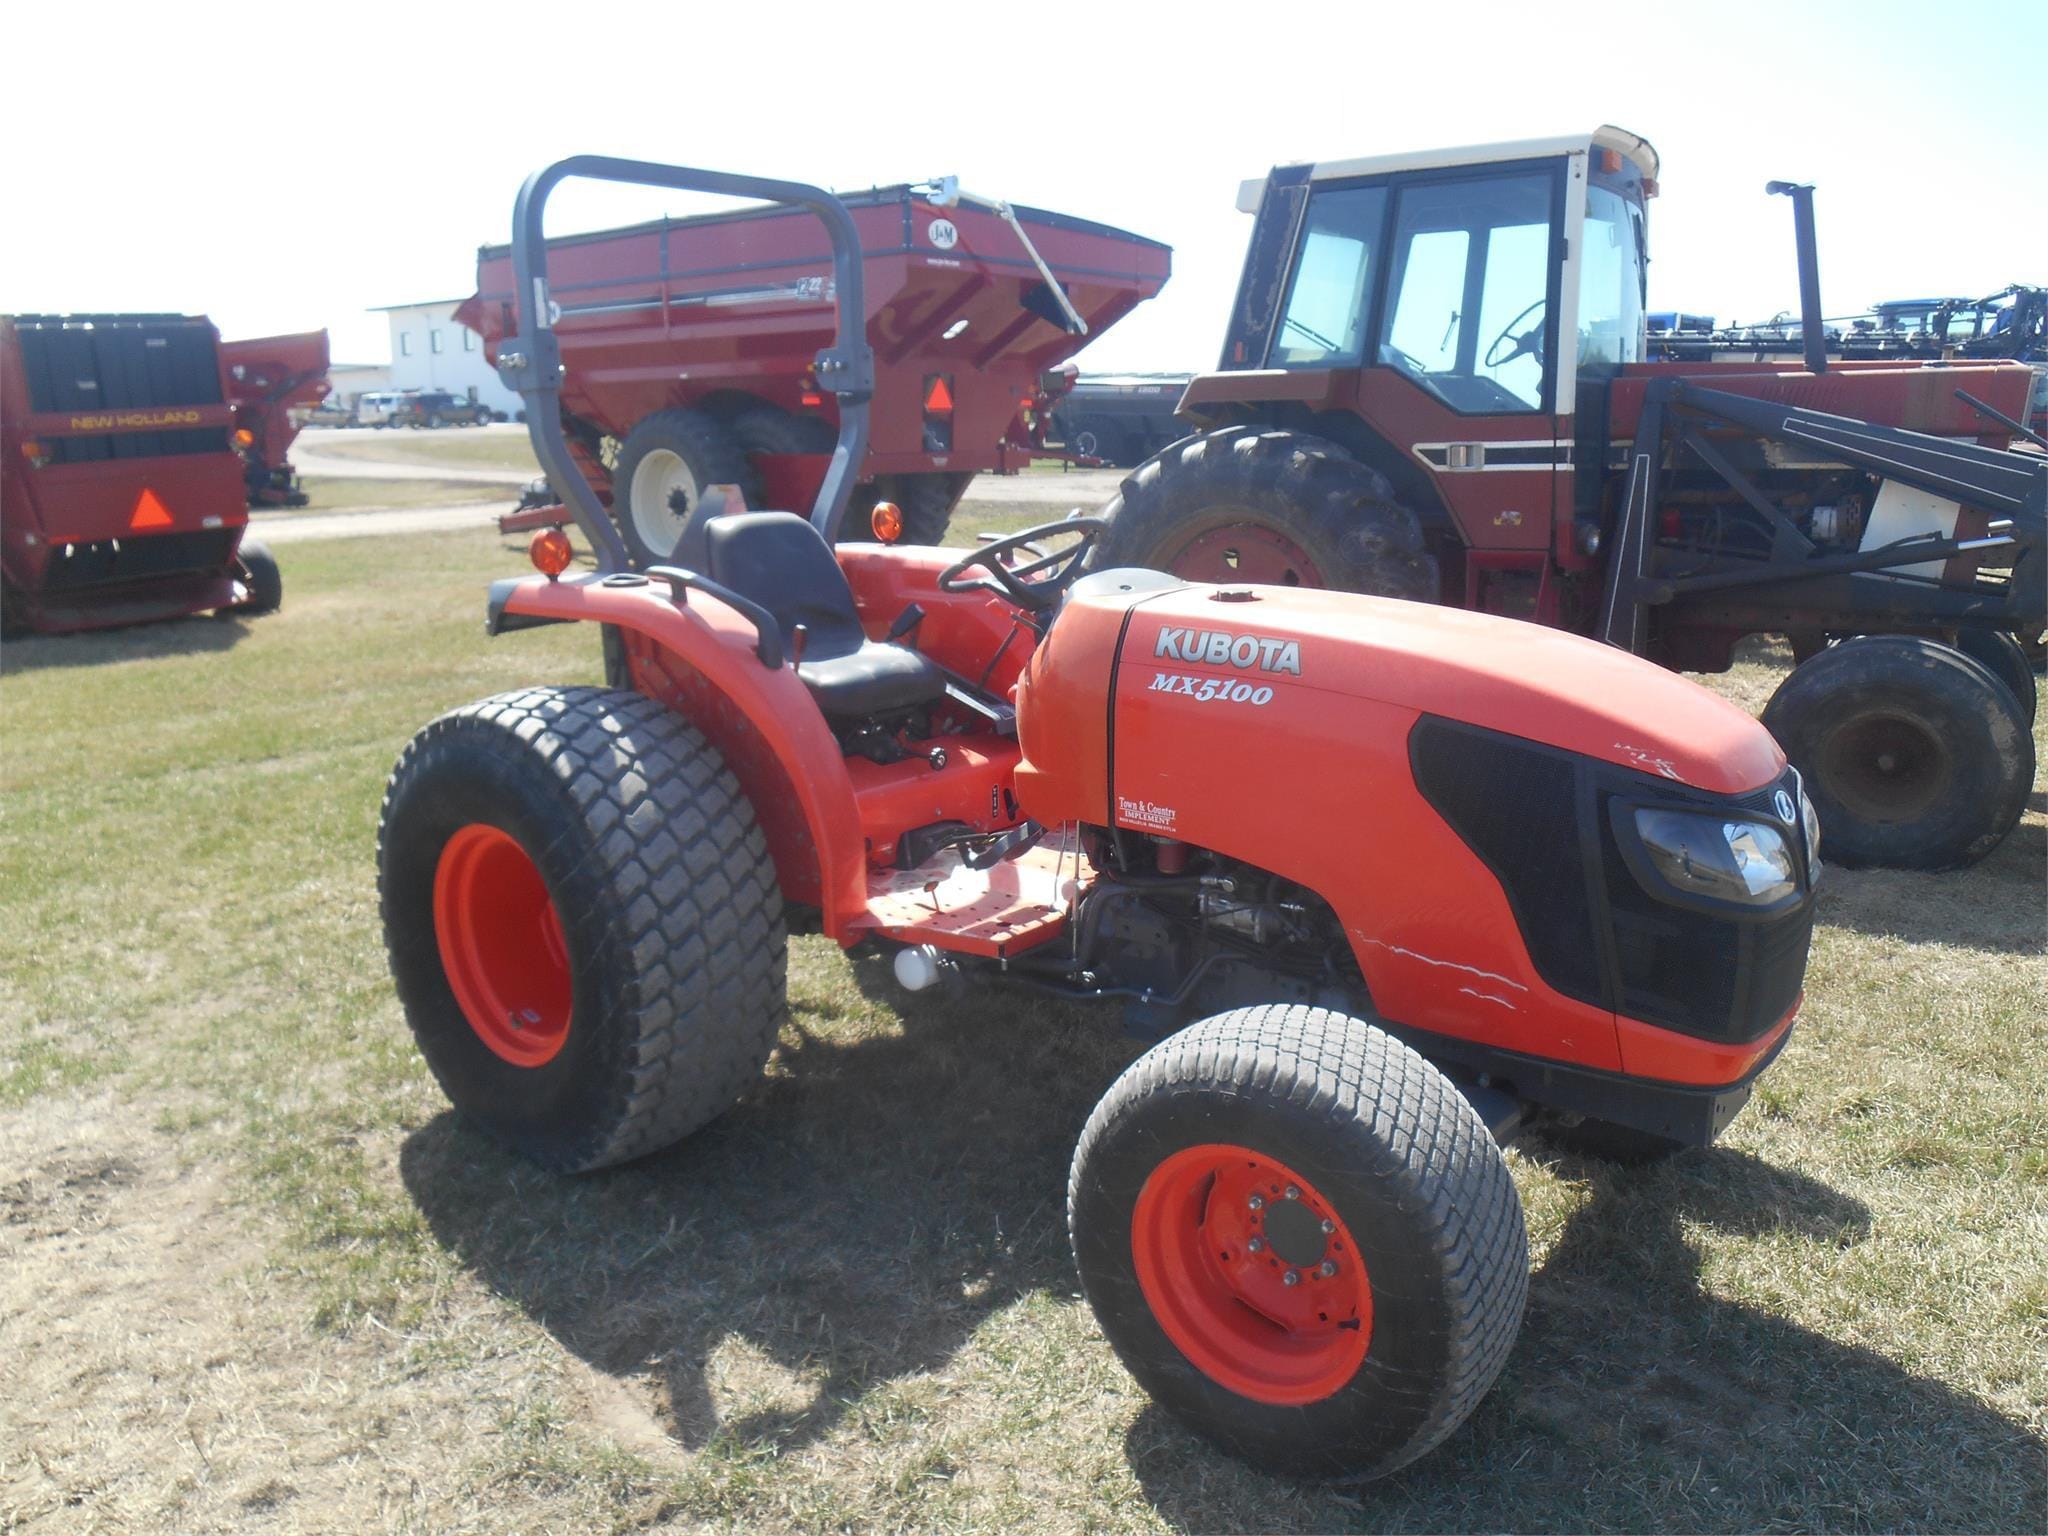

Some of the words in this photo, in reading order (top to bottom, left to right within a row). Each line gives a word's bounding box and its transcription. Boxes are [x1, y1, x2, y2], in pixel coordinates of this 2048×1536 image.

[71, 416, 113, 430] NEW
[116, 410, 199, 426] HOLLAND
[1154, 625, 1301, 675] KUBOTA
[1148, 672, 1274, 705] MX5100
[1118, 796, 1138, 810] Town
[1139, 800, 1146, 812] &
[1147, 801, 1176, 820] Country
[1124, 810, 1170, 825] IMPLEMENT
